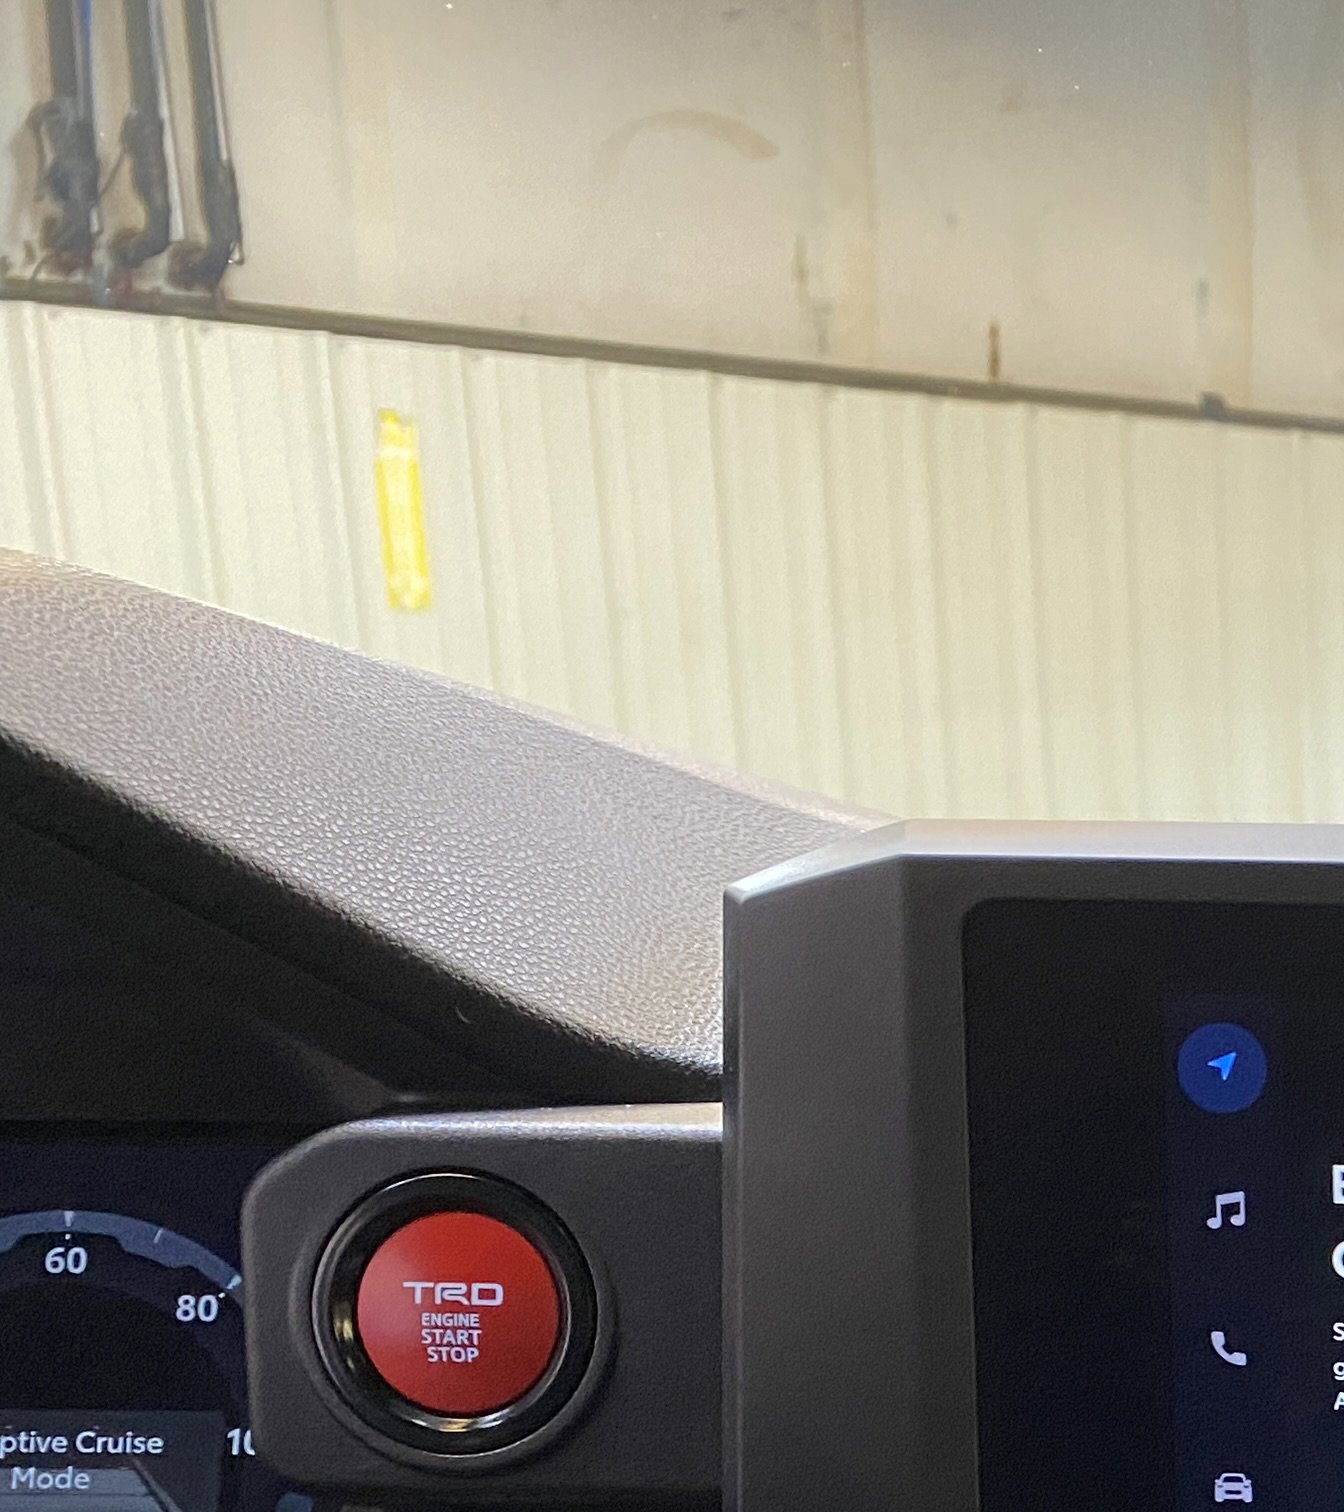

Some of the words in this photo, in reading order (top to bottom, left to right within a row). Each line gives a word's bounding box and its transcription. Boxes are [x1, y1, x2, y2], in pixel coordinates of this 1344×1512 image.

[45, 1247, 88, 1274] 60
[402, 1281, 504, 1306] TRD
[175, 1295, 219, 1322] 80
[421, 1312, 480, 1327] ENGINE
[421, 1328, 482, 1345] START
[427, 1346, 479, 1363] STOP
[75, 1431, 164, 1455] Cruise
[11, 1466, 91, 1490] Mode
